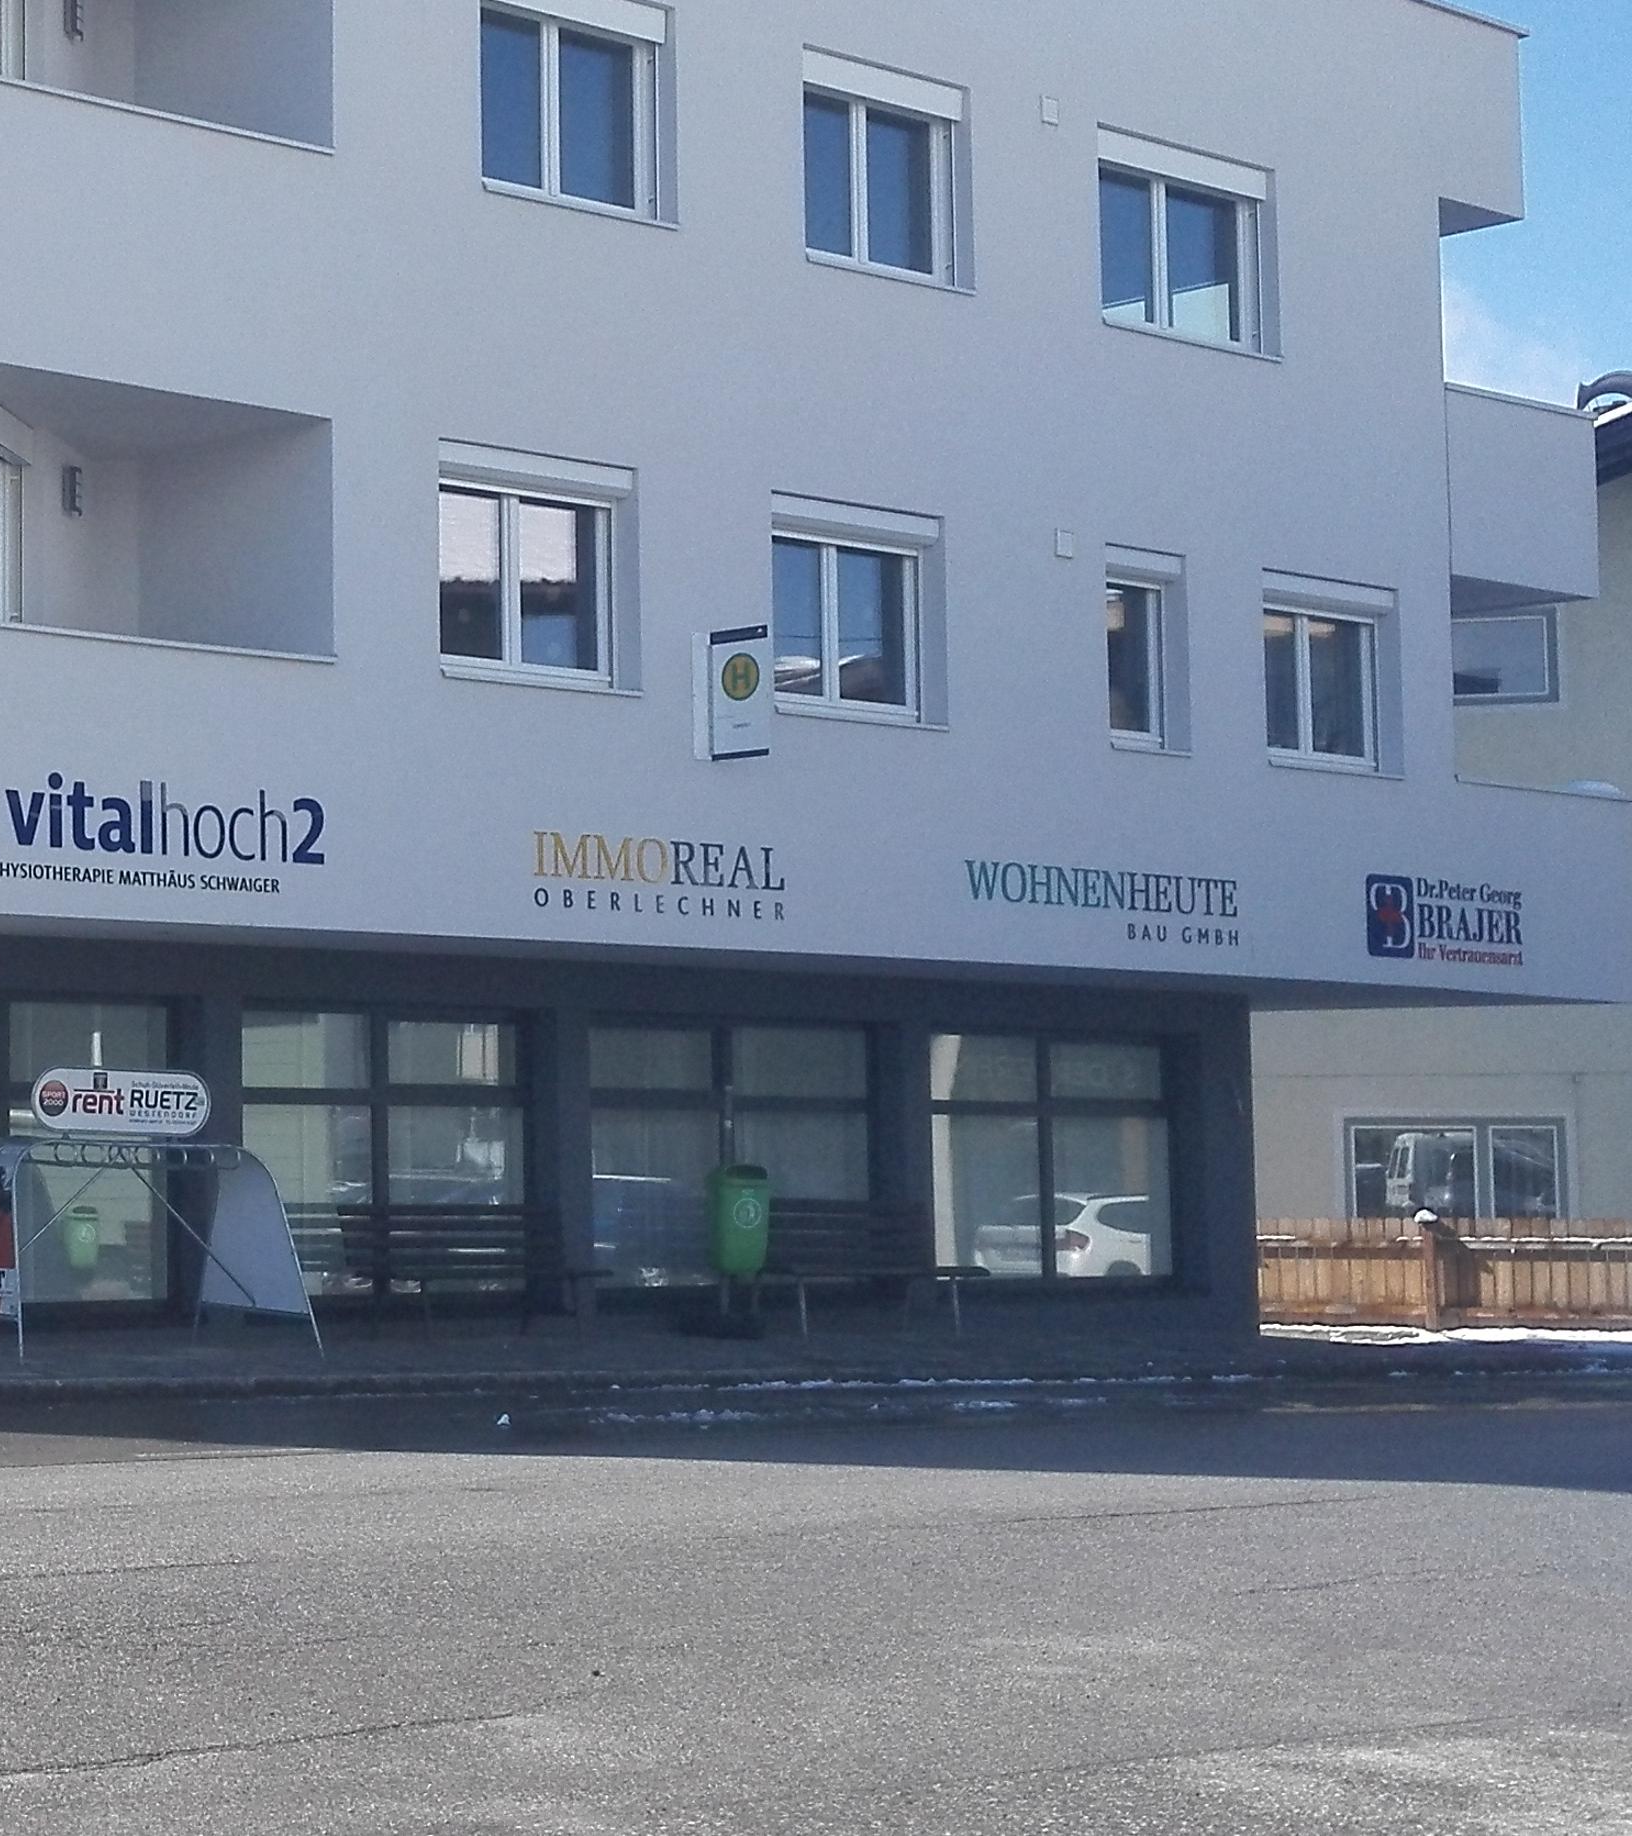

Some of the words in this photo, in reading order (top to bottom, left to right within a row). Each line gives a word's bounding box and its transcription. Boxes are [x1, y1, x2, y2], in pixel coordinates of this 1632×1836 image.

[5, 772, 325, 865] vitalhoch2
[533, 831, 785, 891] IMMOREAL
[118, 869, 195, 889] MATTHÄUS
[200, 875, 280, 893] SCHWAIGER
[965, 859, 1238, 918] WOHNENHEUTE
[534, 888, 785, 920] OBERLECHNER
[1480, 883, 1522, 911] Georg
[1127, 923, 1167, 942] BAU
[1182, 926, 1239, 946] GMBH
[1417, 903, 1523, 945] BRAJER
[42, 1091, 65, 1099] SPORT
[72, 1088, 124, 1115] rent
[130, 1089, 198, 1111] RUETZ
[129, 1110, 197, 1119] WESTENDORF
